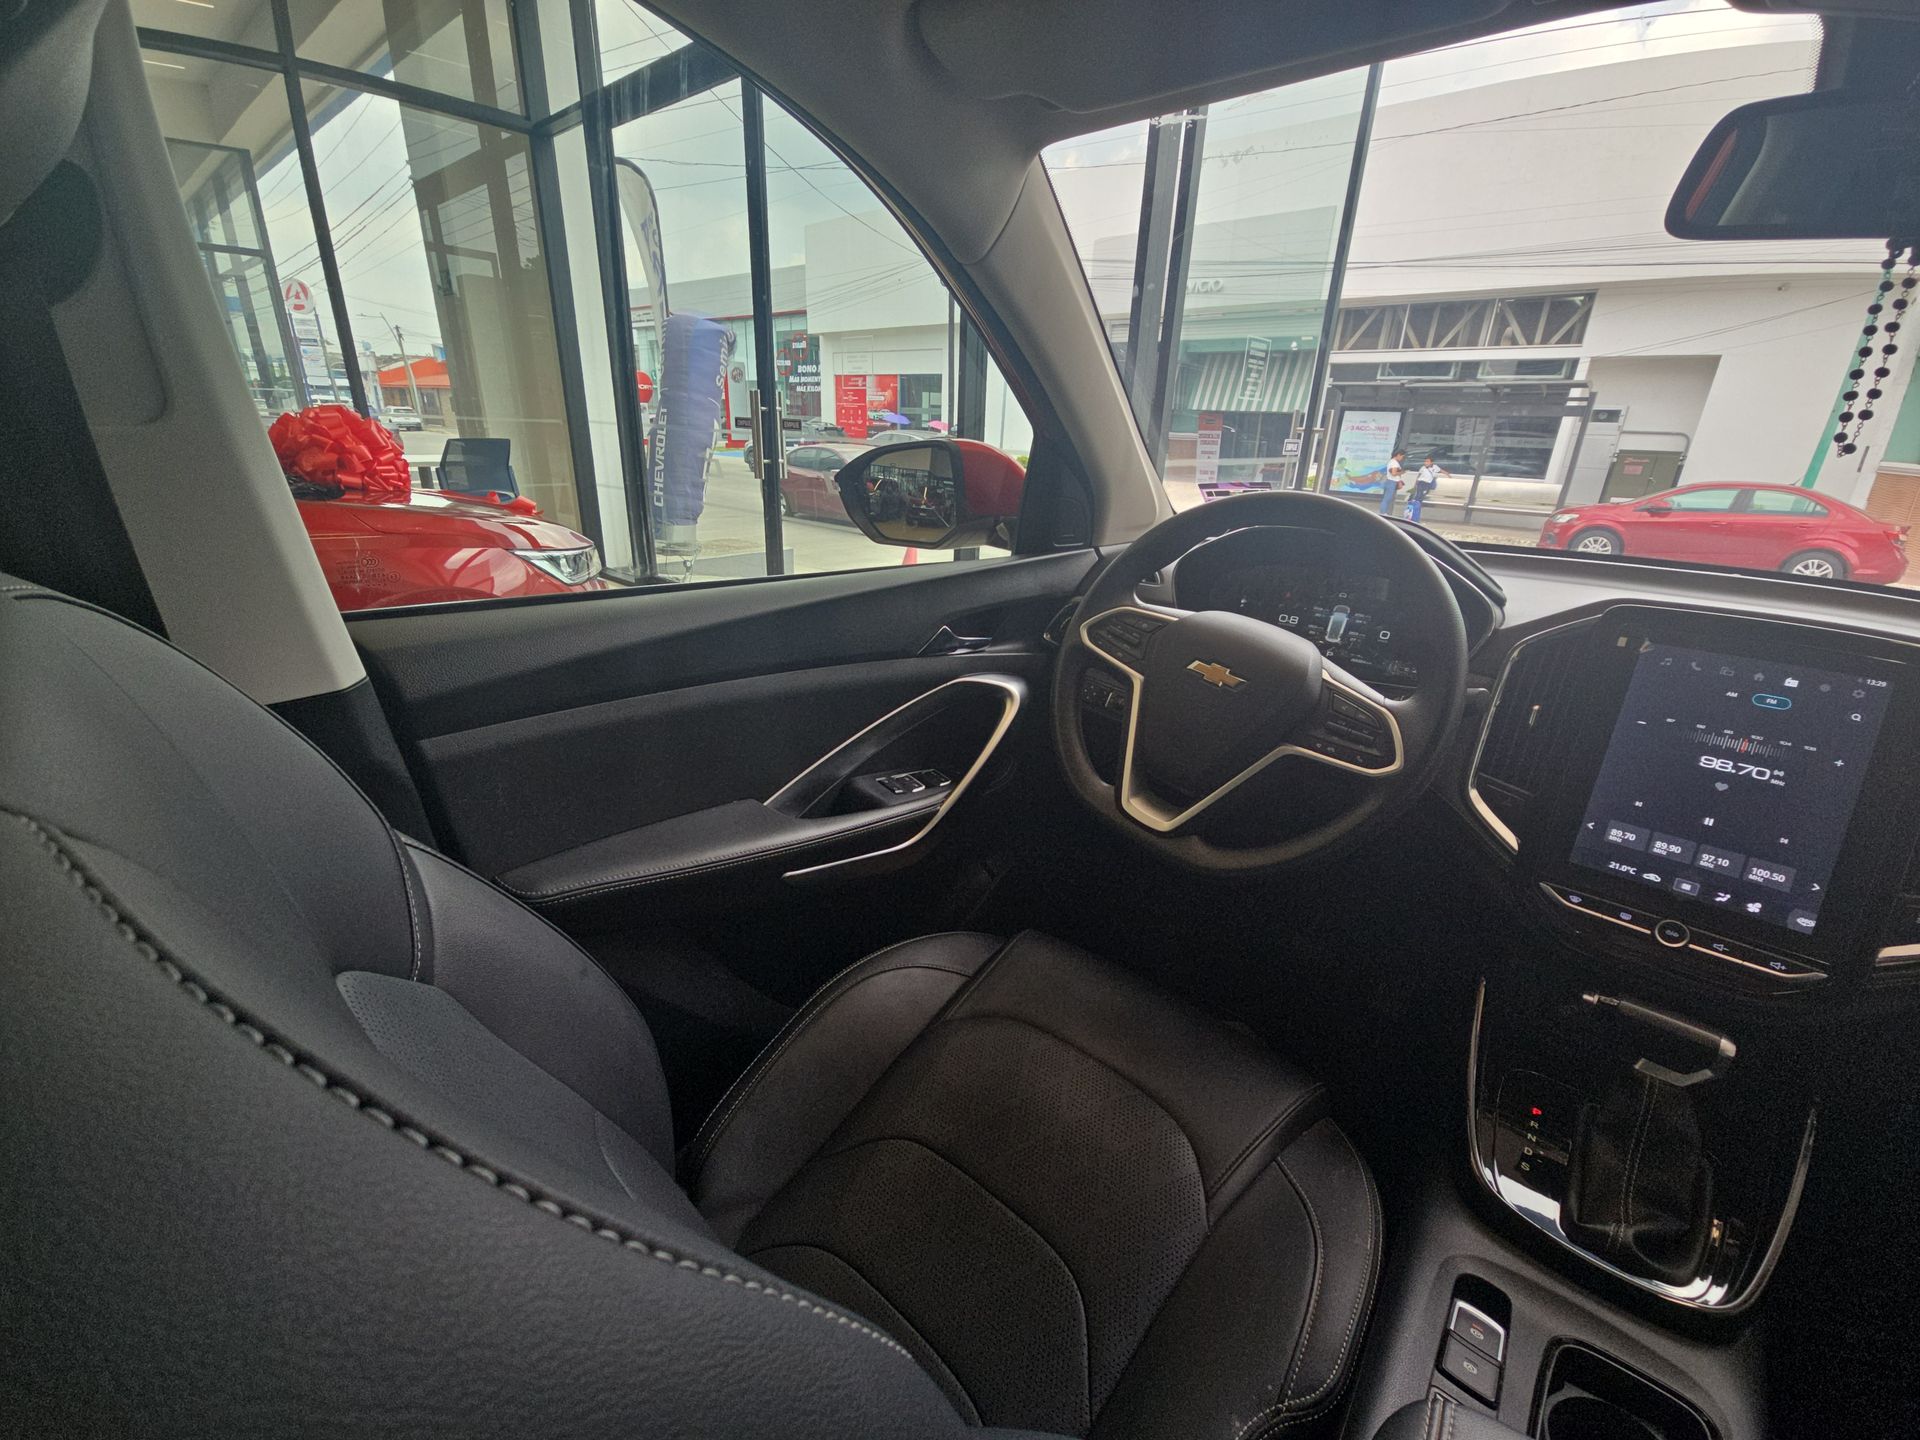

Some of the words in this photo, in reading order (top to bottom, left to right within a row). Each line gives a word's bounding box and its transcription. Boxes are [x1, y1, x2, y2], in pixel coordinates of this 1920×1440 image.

[797, 365, 817, 373] BONO
[653, 407, 667, 507] CHEVROLET
[1866, 679, 1887, 688] 13:29
[1698, 755, 1771, 780] 98.70
[1610, 828, 1636, 842] 89.70
[1654, 840, 1682, 854] 89.90
[1701, 853, 1730, 868] 97.10
[1608, 861, 1637, 876] 21.0°C
[1750, 867, 1786, 883] 100.50
[1529, 1120, 1539, 1129] R
[1524, 1147, 1533, 1156] D
